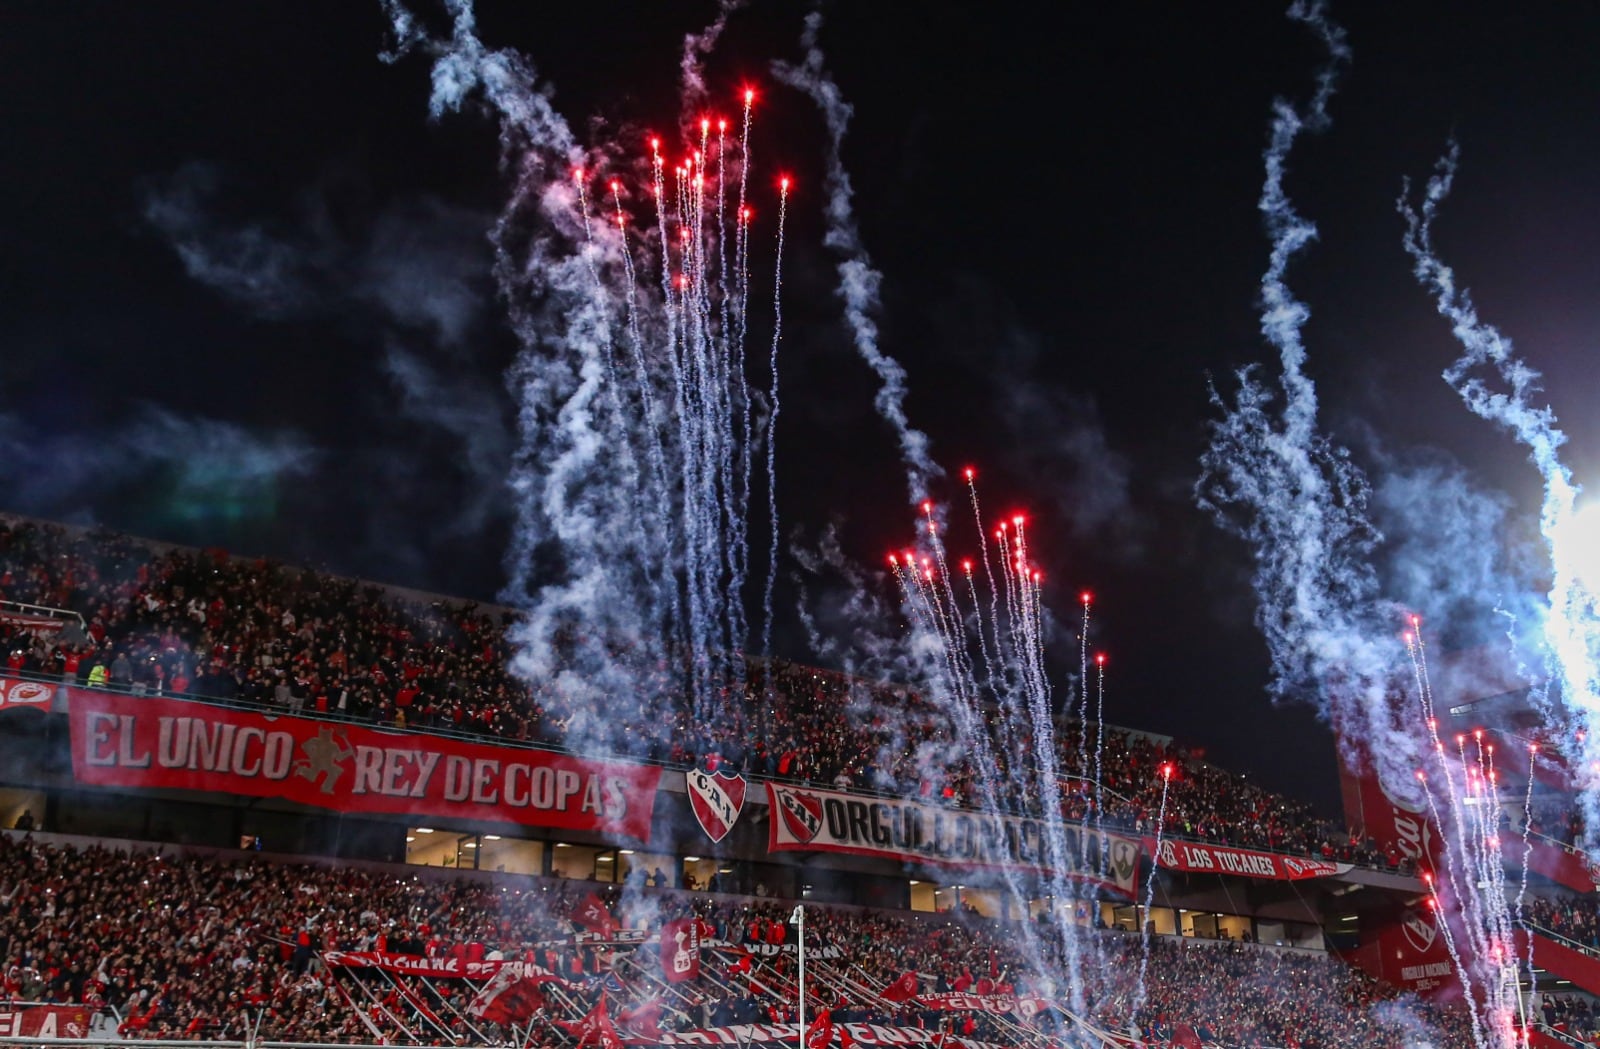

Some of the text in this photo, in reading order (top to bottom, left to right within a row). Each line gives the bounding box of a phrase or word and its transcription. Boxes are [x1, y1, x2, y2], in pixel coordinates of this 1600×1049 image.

[85, 711, 294, 781] EL UNICO
[352, 745, 629, 820] REY DE COPAS
[978, 810, 1117, 881] NACINAL
[1184, 846, 1214, 869] LOS
[1214, 851, 1276, 876] TUCANES
